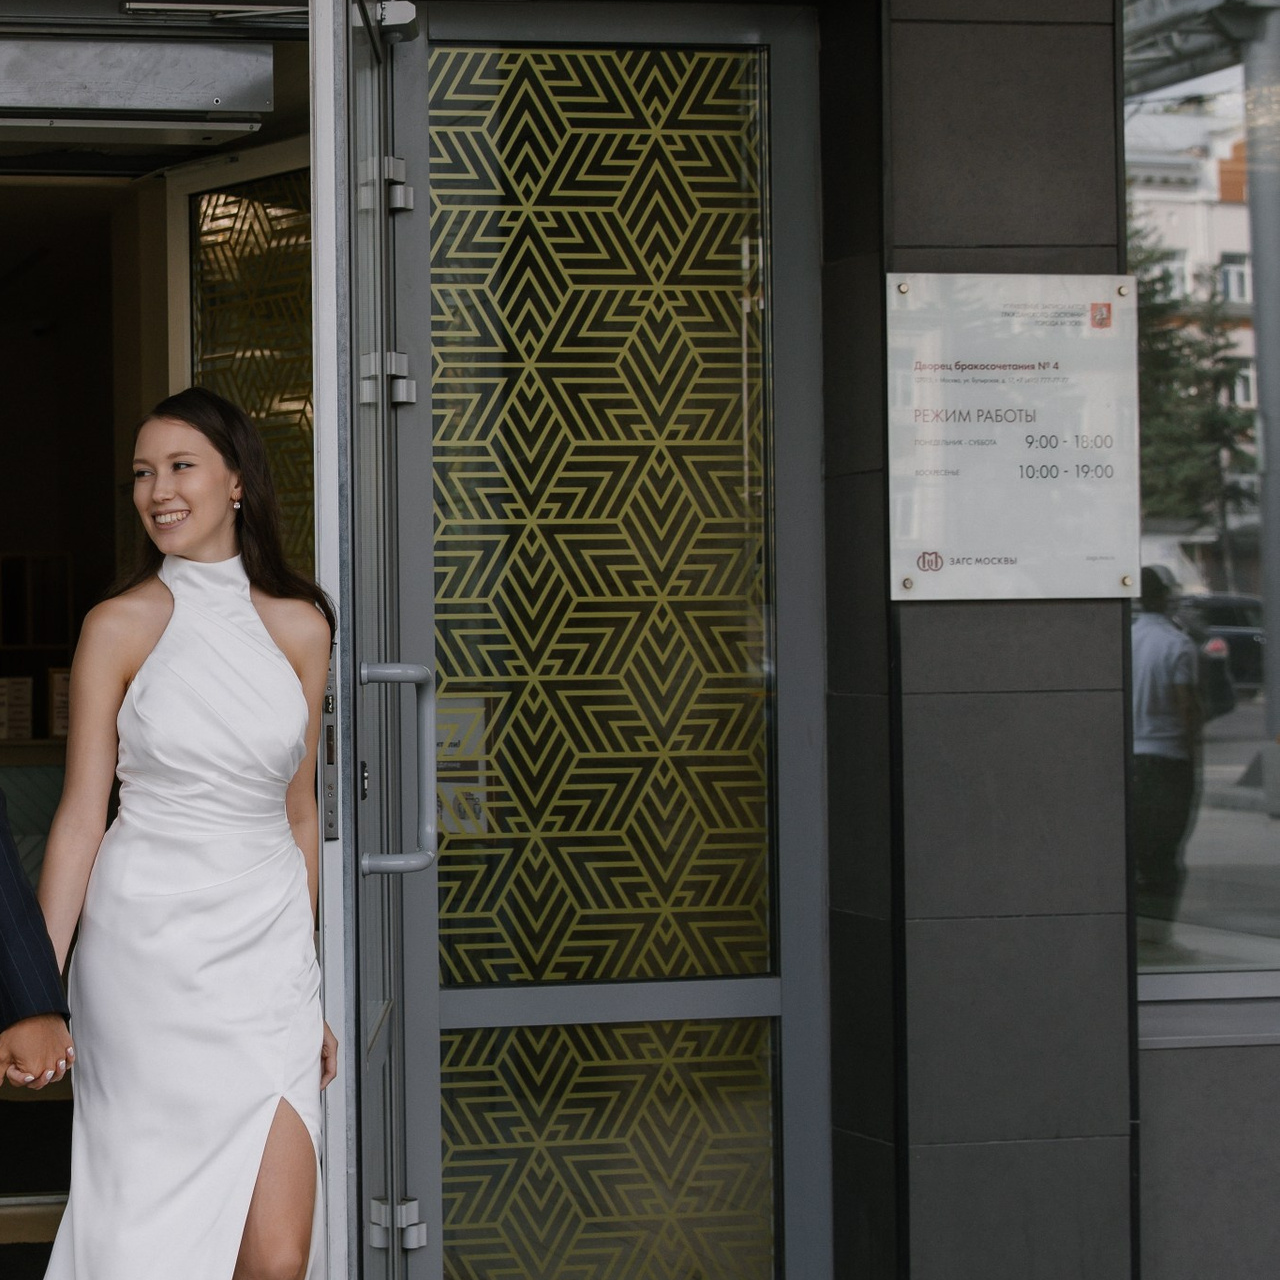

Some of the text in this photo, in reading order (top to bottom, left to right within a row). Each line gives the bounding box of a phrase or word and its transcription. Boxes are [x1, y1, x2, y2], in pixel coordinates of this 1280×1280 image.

[914, 360, 1060, 373] Дворец бракосочетания № 4
[914, 408, 1037, 423] РЕЖИМ РАБОТЫ
[1024, 435, 1059, 449] 9:00
[1074, 434, 1114, 449] 18:00
[1018, 465, 1059, 479] 10:00
[1074, 464, 1114, 479] 19:00
[949, 556, 1017, 566] ЗАГС МОСКВЫ
